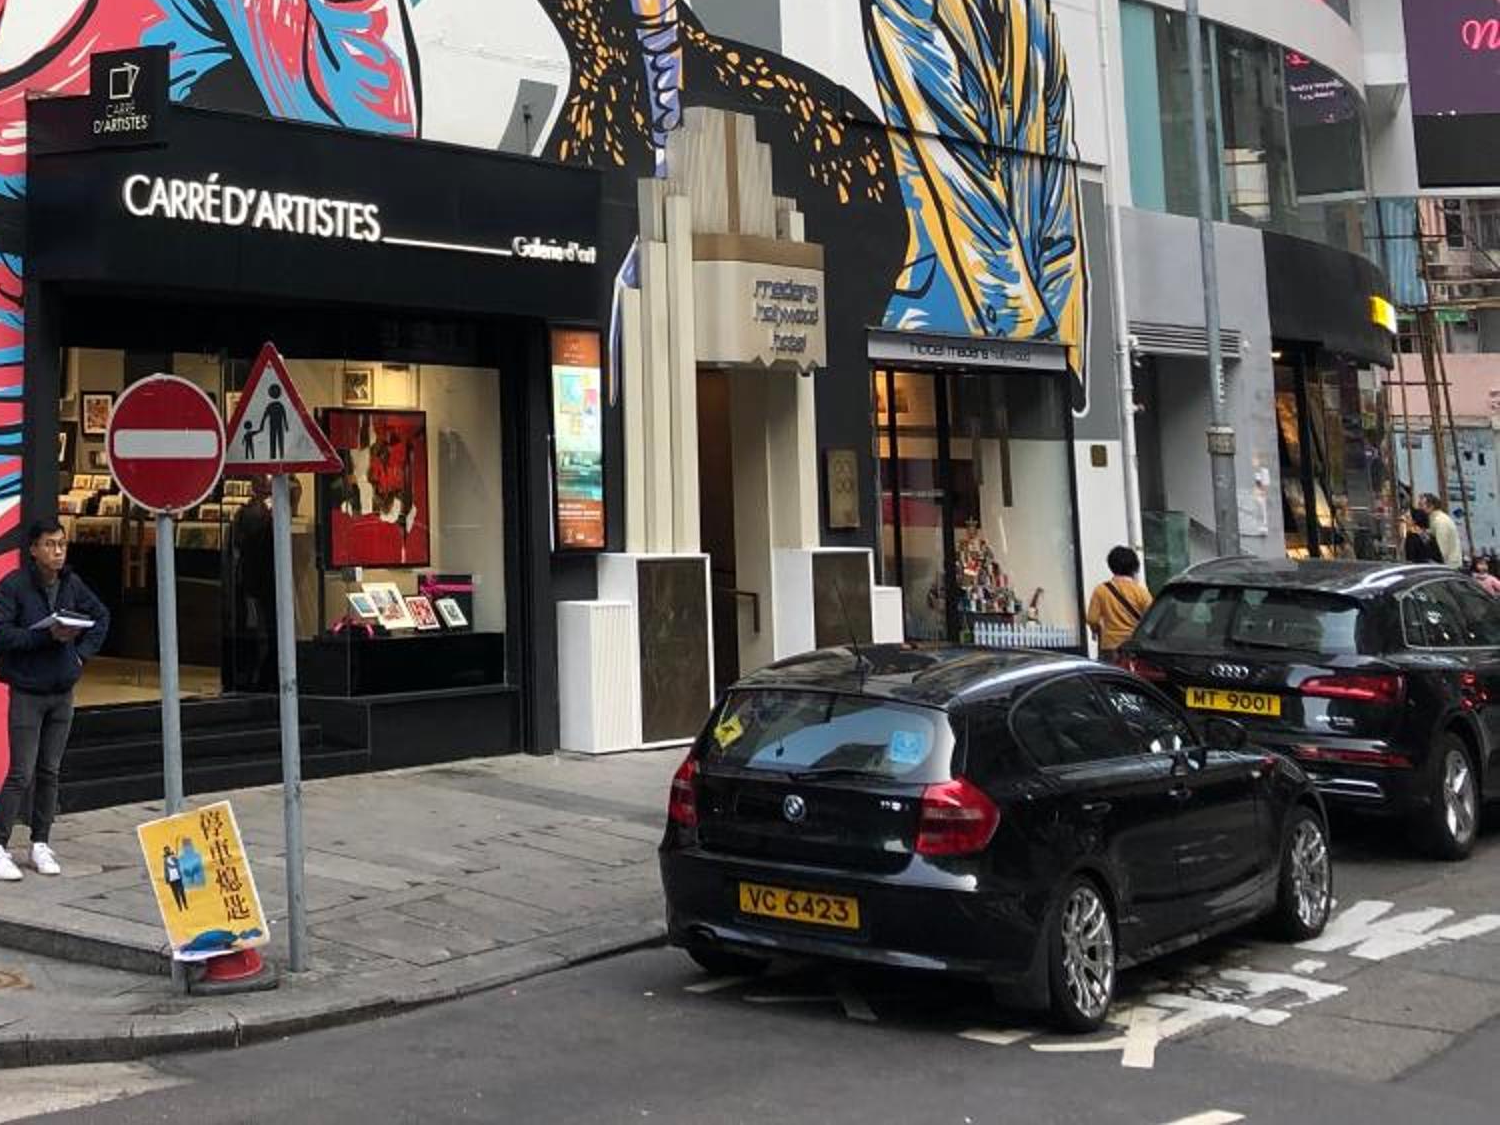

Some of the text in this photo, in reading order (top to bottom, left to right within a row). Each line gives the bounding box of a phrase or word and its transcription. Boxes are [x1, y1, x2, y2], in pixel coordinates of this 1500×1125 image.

[124, 172, 380, 243] CARRÉ D'ARTISTES
[1193, 690, 1272, 711] MT 9001
[747, 886, 849, 922] VC 6423
